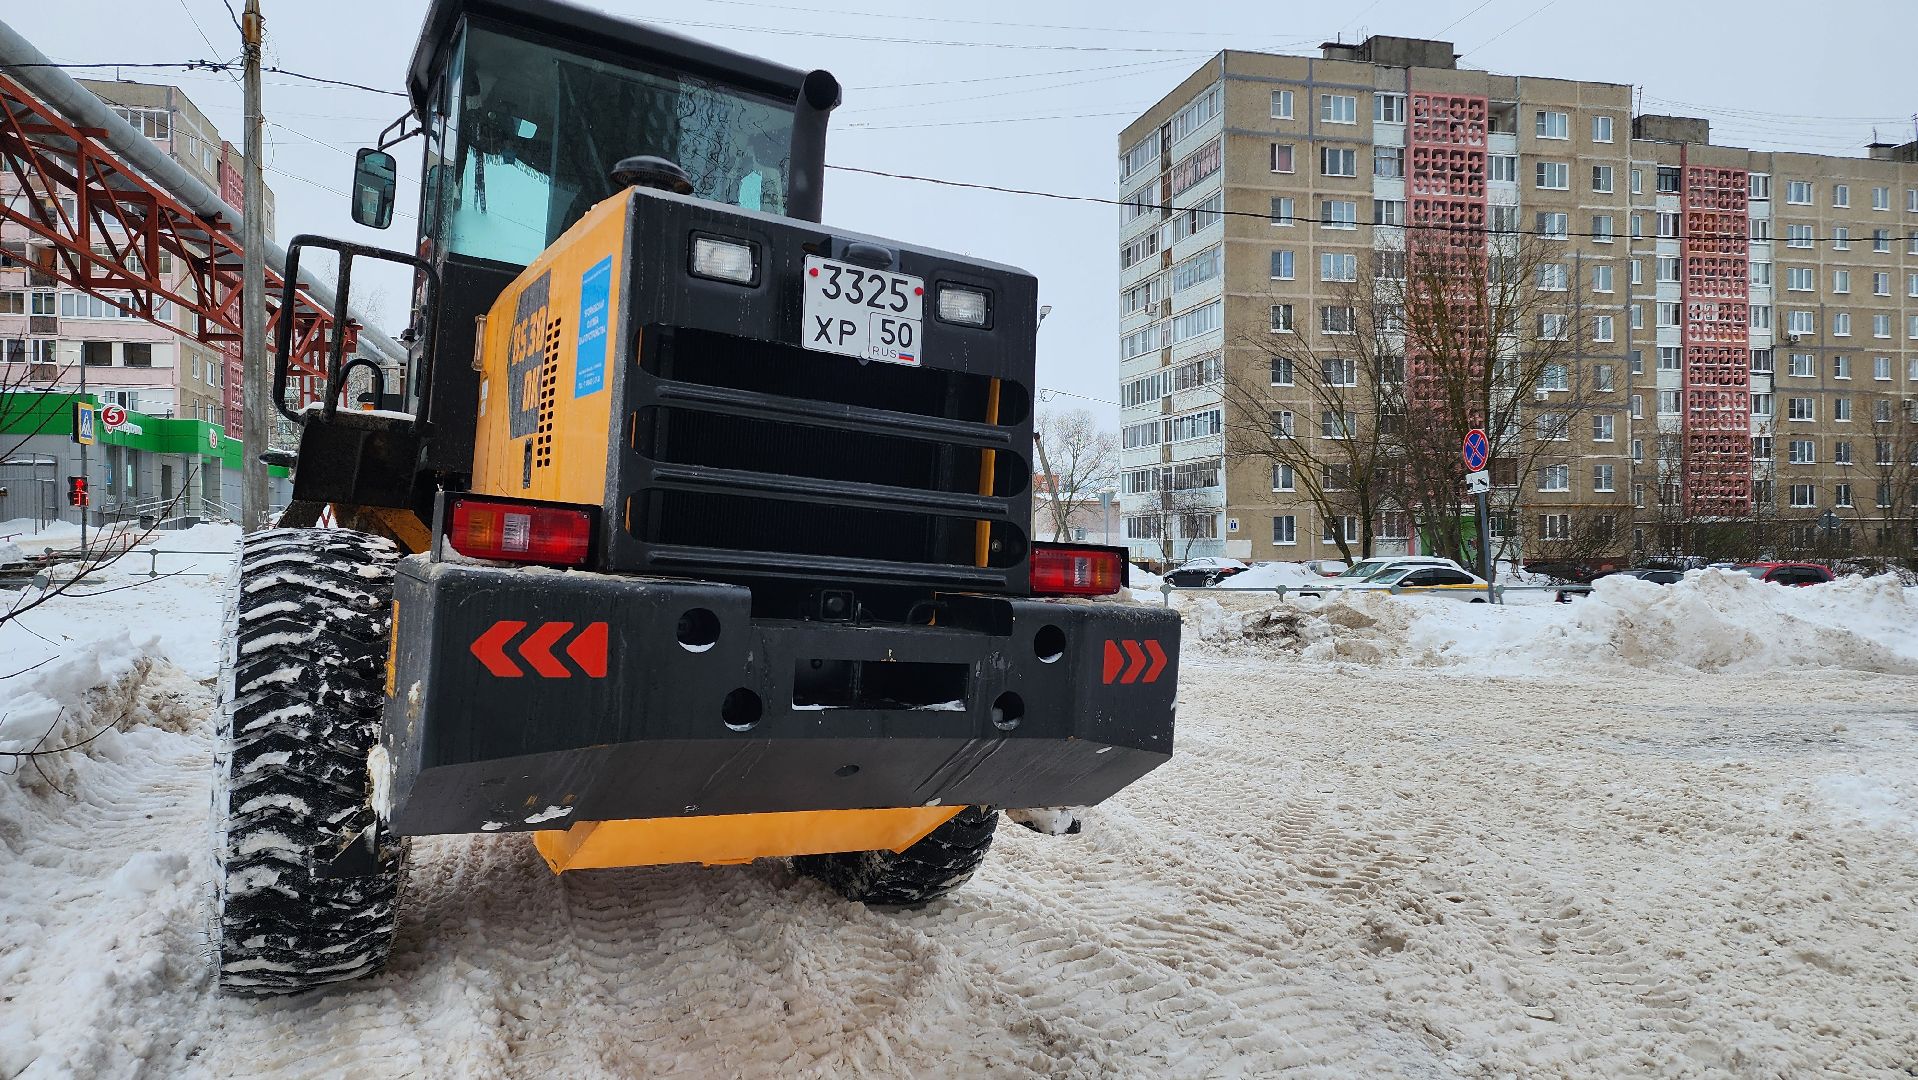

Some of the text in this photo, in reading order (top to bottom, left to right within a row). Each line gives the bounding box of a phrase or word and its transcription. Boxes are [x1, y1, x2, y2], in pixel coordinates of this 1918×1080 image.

[822, 264, 909, 313] 3325
[814, 315, 913, 348] ХР 50
[872, 345, 897, 359] RUS
